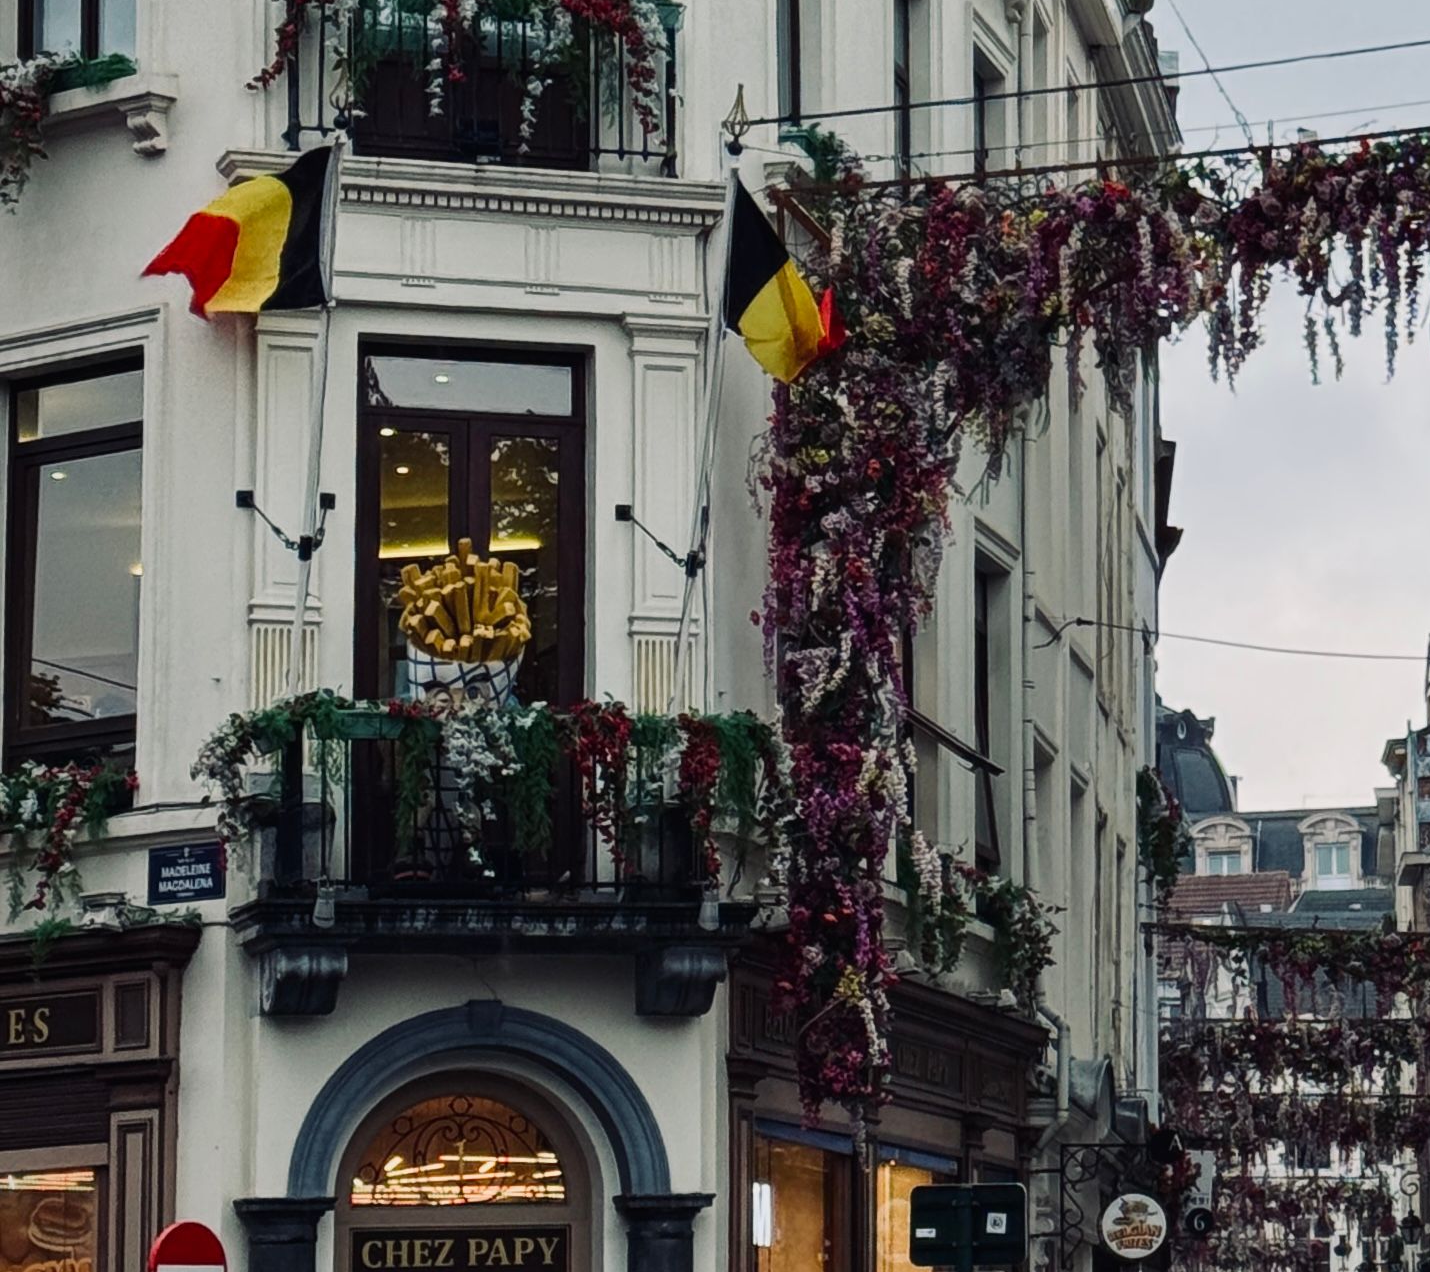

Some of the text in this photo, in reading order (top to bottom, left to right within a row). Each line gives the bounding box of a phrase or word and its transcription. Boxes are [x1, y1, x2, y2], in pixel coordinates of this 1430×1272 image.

[161, 862, 211, 878] MADELEINE
[158, 876, 213, 893] MAGDALENA
[1193, 1214, 1206, 1232] 6
[361, 1236, 560, 1269] CHEZ PAPY
